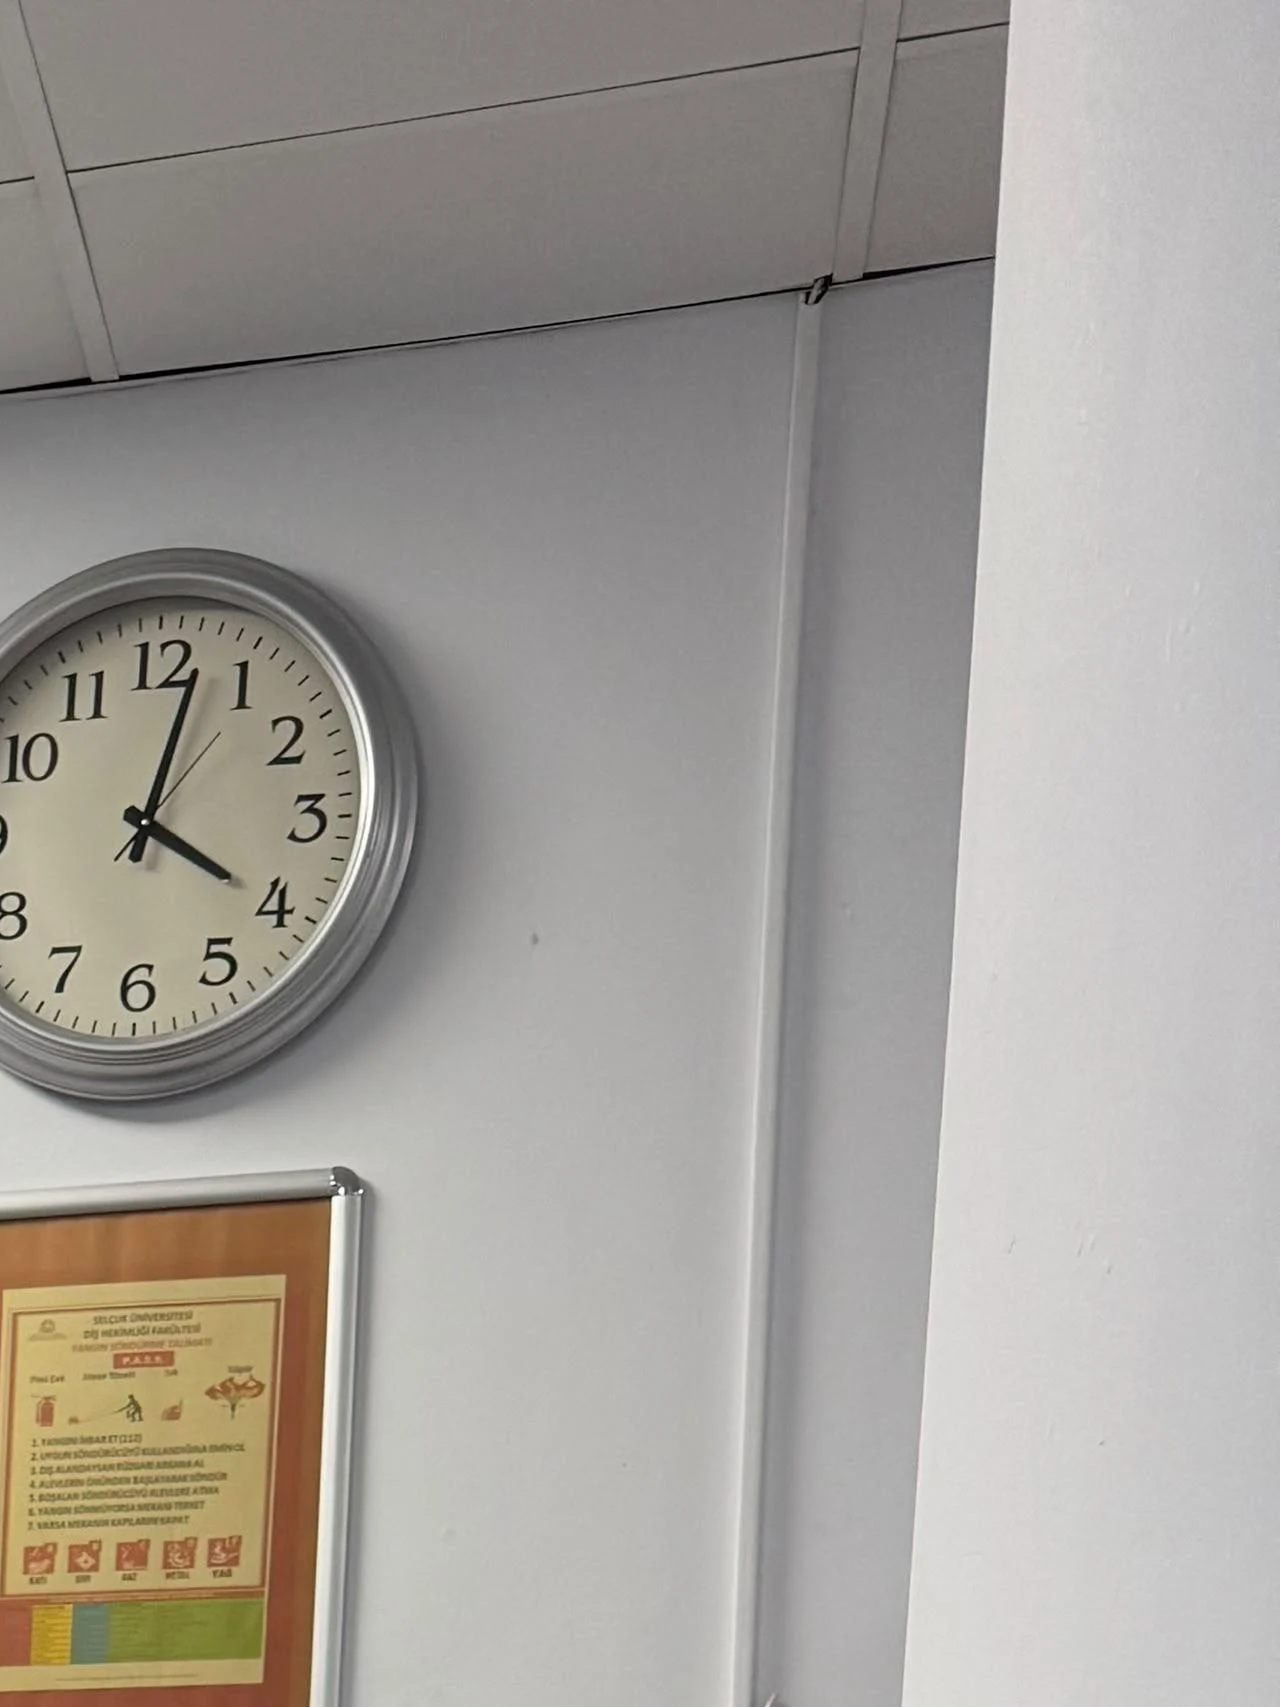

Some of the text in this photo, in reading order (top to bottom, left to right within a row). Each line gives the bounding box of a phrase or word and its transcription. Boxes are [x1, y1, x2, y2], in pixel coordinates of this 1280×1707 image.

[131, 640, 194, 691] 12
[230, 660, 253, 710] 1
[60, 670, 108, 722] 11
[2, 732, 59, 784] 10
[266, 716, 306, 766] 2
[286, 794, 327, 843] 3
[255, 876, 295, 928] 4
[48, 945, 83, 994] 7
[198, 937, 239, 986] 5
[119, 963, 157, 1012] 6
